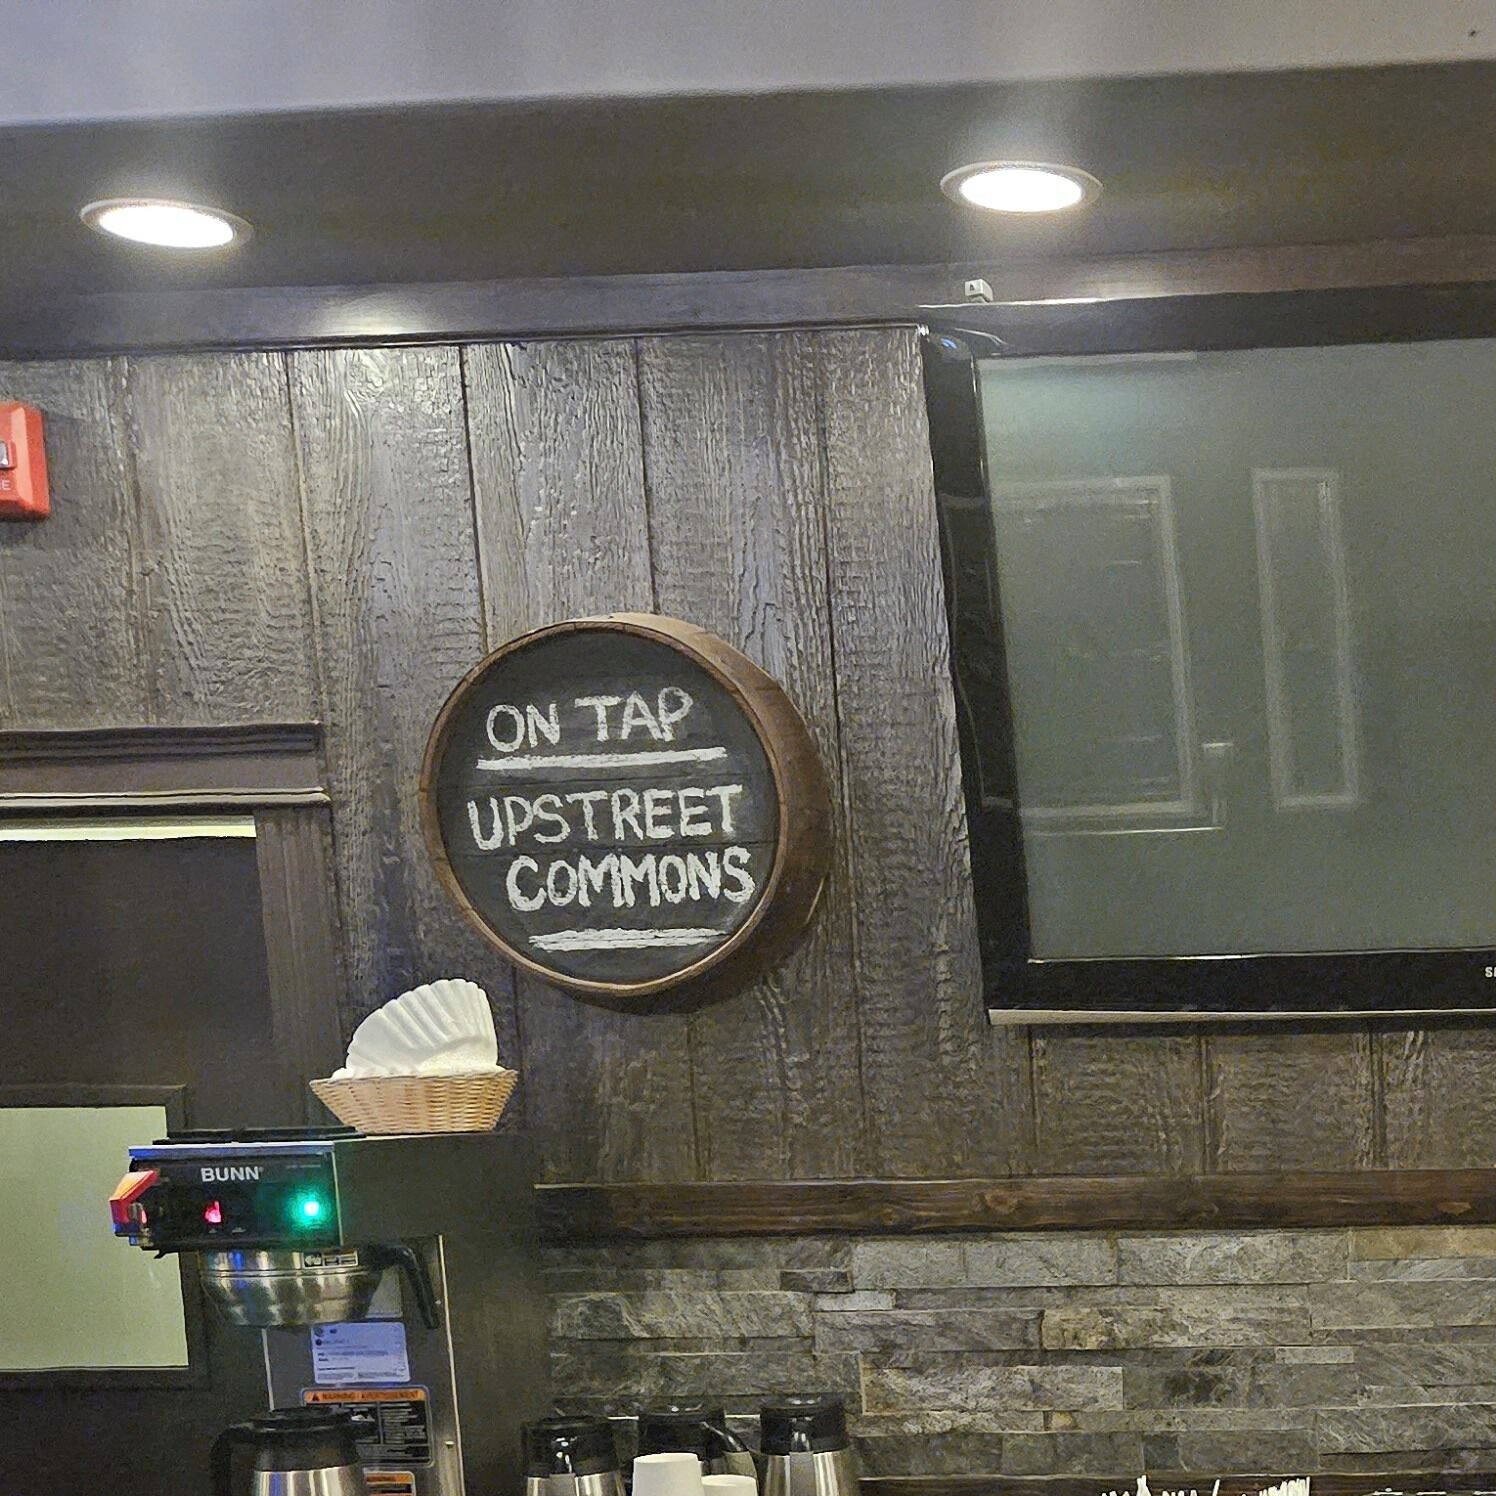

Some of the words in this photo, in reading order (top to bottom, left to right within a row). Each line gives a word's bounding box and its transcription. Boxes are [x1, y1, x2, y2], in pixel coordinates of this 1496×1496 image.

[486, 703, 561, 752] ON
[575, 687, 693, 742] TAP
[467, 784, 743, 850] UPSTREET
[505, 845, 756, 912] COMMONS
[201, 1166, 260, 1182] BUNN
